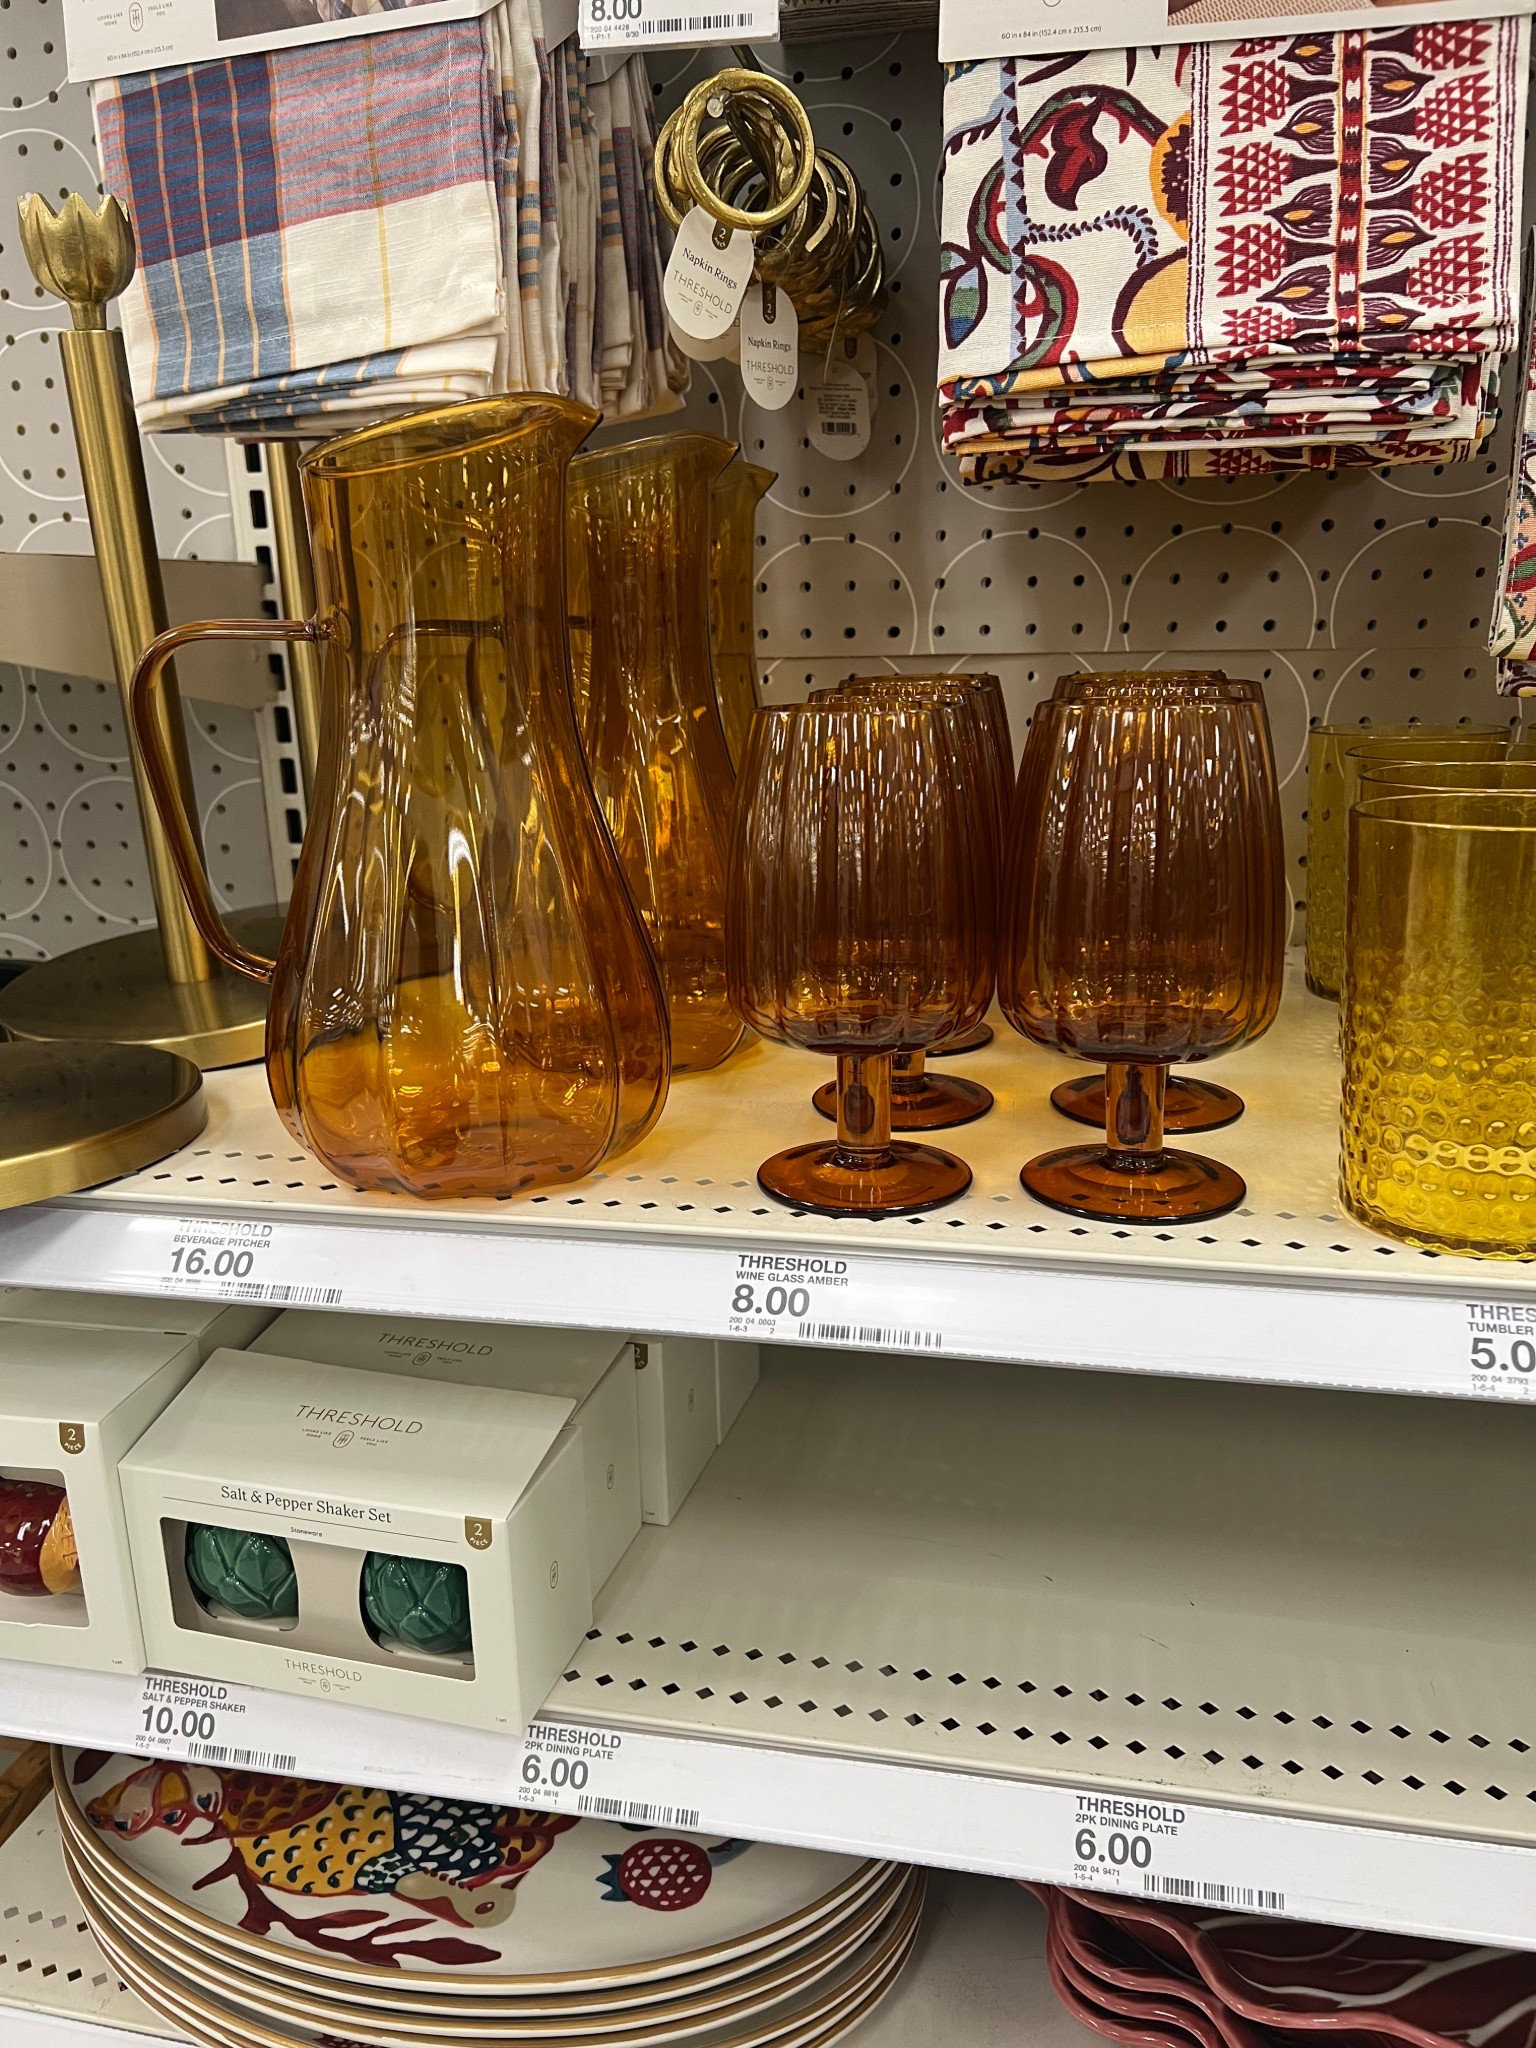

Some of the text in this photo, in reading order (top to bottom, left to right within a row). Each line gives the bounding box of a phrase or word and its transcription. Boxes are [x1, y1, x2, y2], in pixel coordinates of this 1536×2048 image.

[591, 0, 642, 21] 8.00
[590, 25, 602, 33] 200
[1001, 32, 1011, 40] 60
[1012, 31, 1018, 39] in
[1023, 30, 1031, 38] 84
[1032, 29, 1038, 37] in
[1039, 28, 1057, 38] (152.4
[1073, 25, 1090, 34] 213.3
[1090, 25, 1102, 33] cm)
[718, 227, 726, 239] 2
[682, 247, 738, 290] Napkin Rings
[673, 269, 733, 315] THRESHOLD
[766, 303, 772, 314] 2
[747, 336, 792, 353] Napkin Rings
[746, 360, 794, 375] THRESHOLD
[173, 1235, 271, 1249] BEVERAGE PITCHER
[170, 1247, 254, 1278] 16.00
[738, 1254, 847, 1275] THRESHOLD
[735, 1271, 849, 1287] WINE GLASS AMBER
[731, 1284, 810, 1318] 8.00
[729, 1316, 743, 1324] 200
[1467, 1321, 1534, 1336] TUMBLER
[769, 1327, 775, 1335] 2
[378, 1333, 493, 1356] THRESHOLD
[1470, 1337, 1536, 1373] 5.0
[1470, 1373, 1487, 1382] 200
[1490, 1375, 1502, 1383] 04
[296, 1404, 423, 1434] THRESHOLD
[67, 1428, 76, 1441] 2
[221, 1485, 392, 1524] Salt & Pepper Shaker Set
[290, 1526, 323, 1538] Stoneware
[474, 1523, 483, 1536] 2
[284, 1659, 362, 1682] THRESHOLD
[145, 1677, 228, 1700] THRESHOLD
[142, 1692, 246, 1714] SALT & PEPPER SHAKER
[142, 1705, 216, 1740] 10.00
[135, 1734, 146, 1742] 200
[527, 1724, 622, 1749] THRESHOLD
[524, 1740, 614, 1760] 2PK DINING PLATE
[522, 1753, 589, 1790] 6.00
[518, 1786, 531, 1794] 200
[532, 1788, 541, 1796] 04
[1075, 1795, 1185, 1824] THRESHOLD
[1075, 1813, 1178, 1836] 2PK DINING PLATE
[1075, 1828, 1152, 1869] 6.00
[1074, 1864, 1121, 1877] 200 04 9471
[1074, 1873, 1120, 1886] 1-5-4 1
